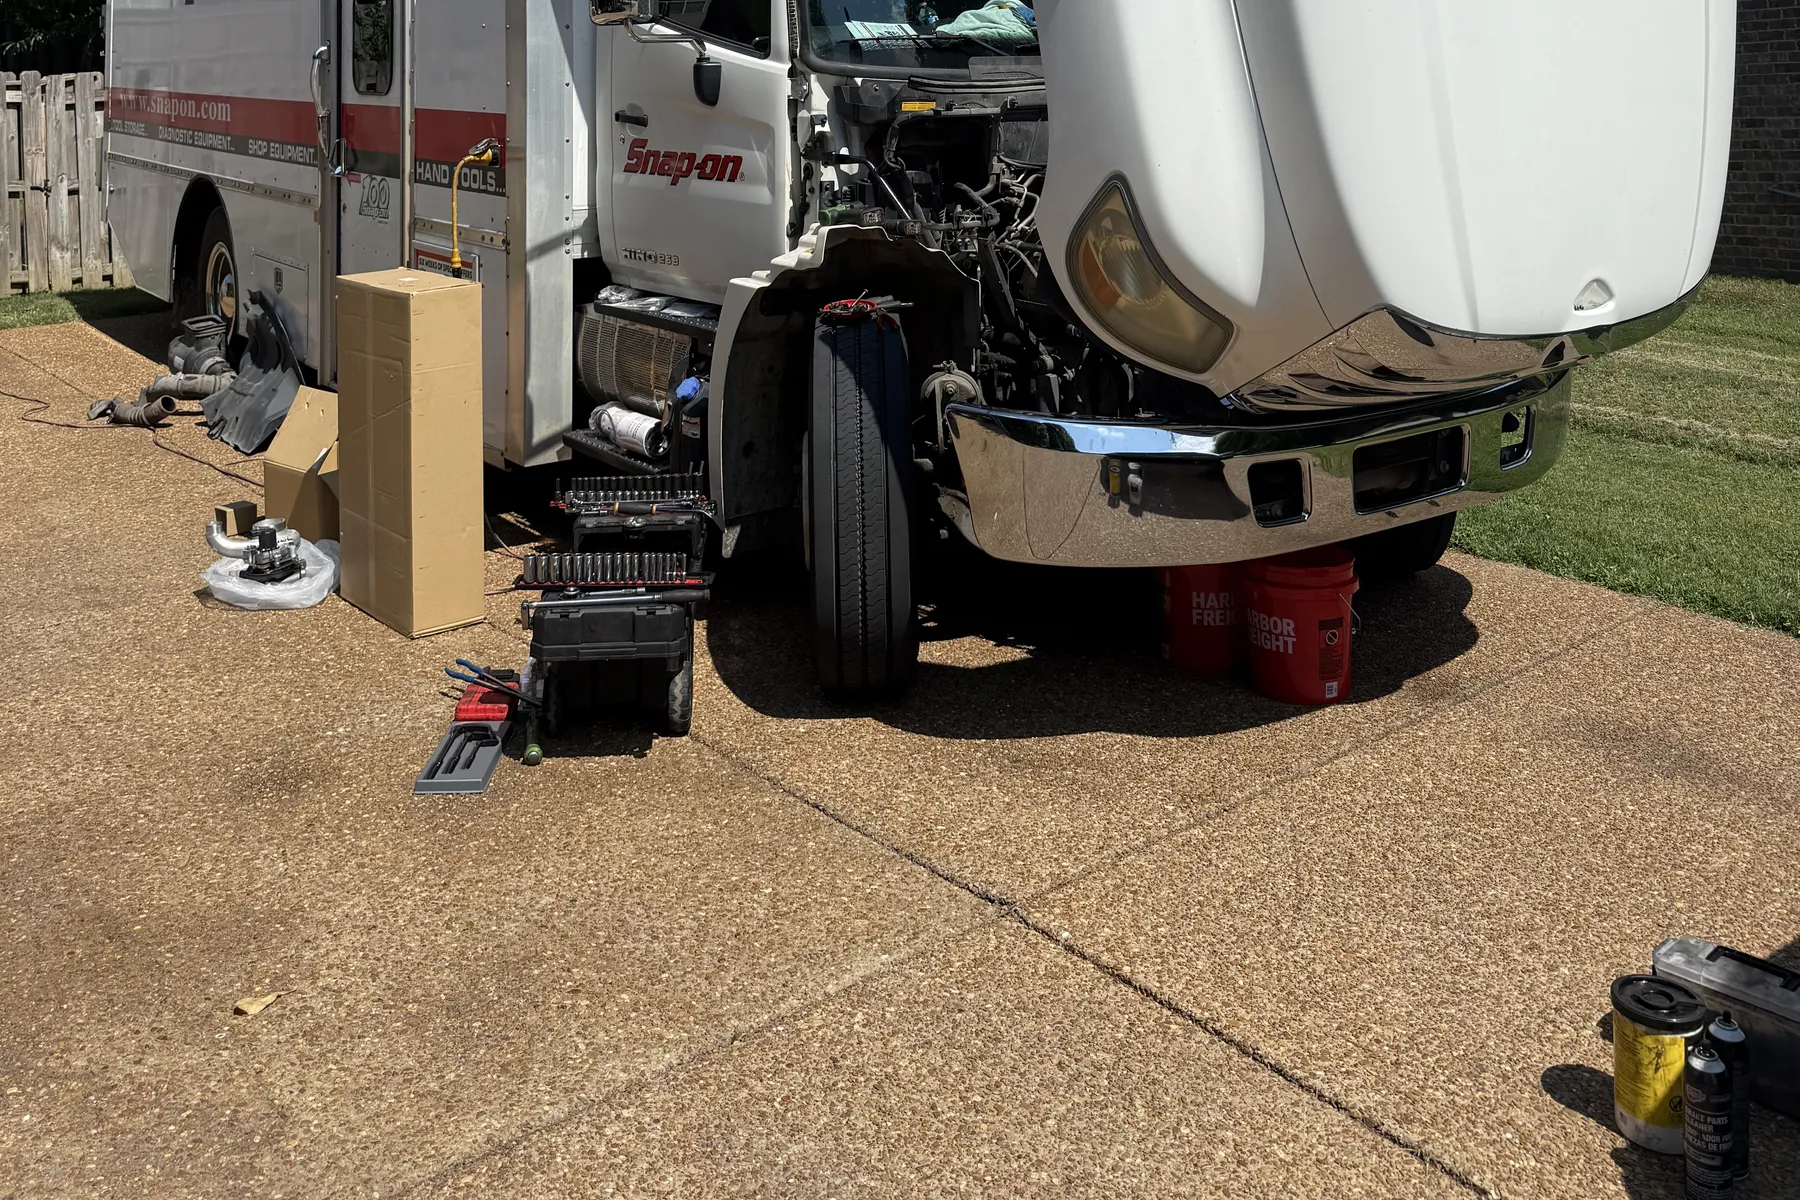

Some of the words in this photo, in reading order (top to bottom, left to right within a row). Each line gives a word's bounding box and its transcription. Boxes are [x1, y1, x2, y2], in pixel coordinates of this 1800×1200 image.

[119, 93, 231, 122] www.snapon.com
[158, 126, 193, 145] DIAGNOSTIC
[248, 138, 268, 156] SHOP
[416, 161, 450, 184] HAND
[361, 174, 391, 209] 100
[361, 202, 390, 220] Snap-on
[658, 253, 680, 267] 268
[461, 269, 472, 279] FFERS
[1247, 607, 1296, 637] ARBOR
[1706, 1116, 1729, 1126] PARTS
[1708, 1142, 1719, 1151] DE
